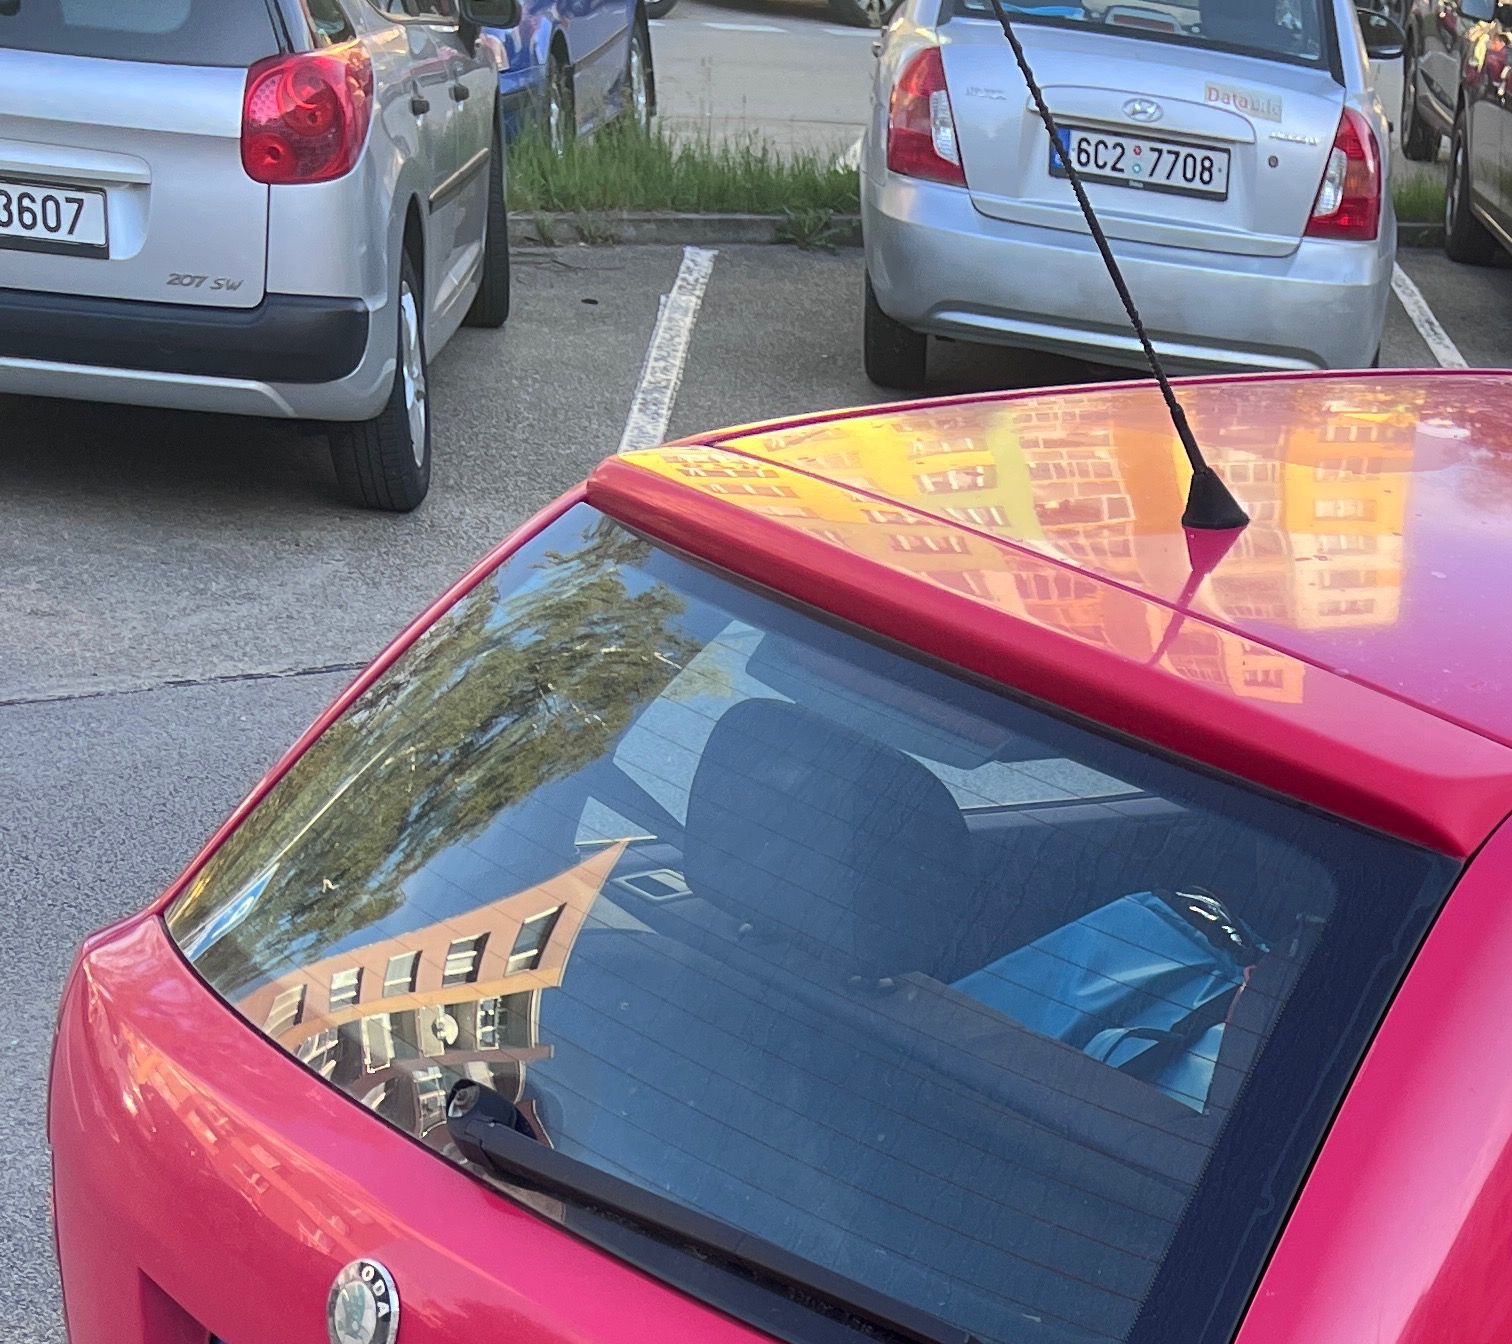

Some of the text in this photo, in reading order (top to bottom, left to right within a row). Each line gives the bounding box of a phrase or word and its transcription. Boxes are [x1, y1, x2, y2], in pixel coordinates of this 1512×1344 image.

[1077, 137, 1125, 173] 6C2
[1149, 147, 1214, 185] 7708
[0, 189, 84, 235] 3607
[166, 273, 244, 291] 207 SW
